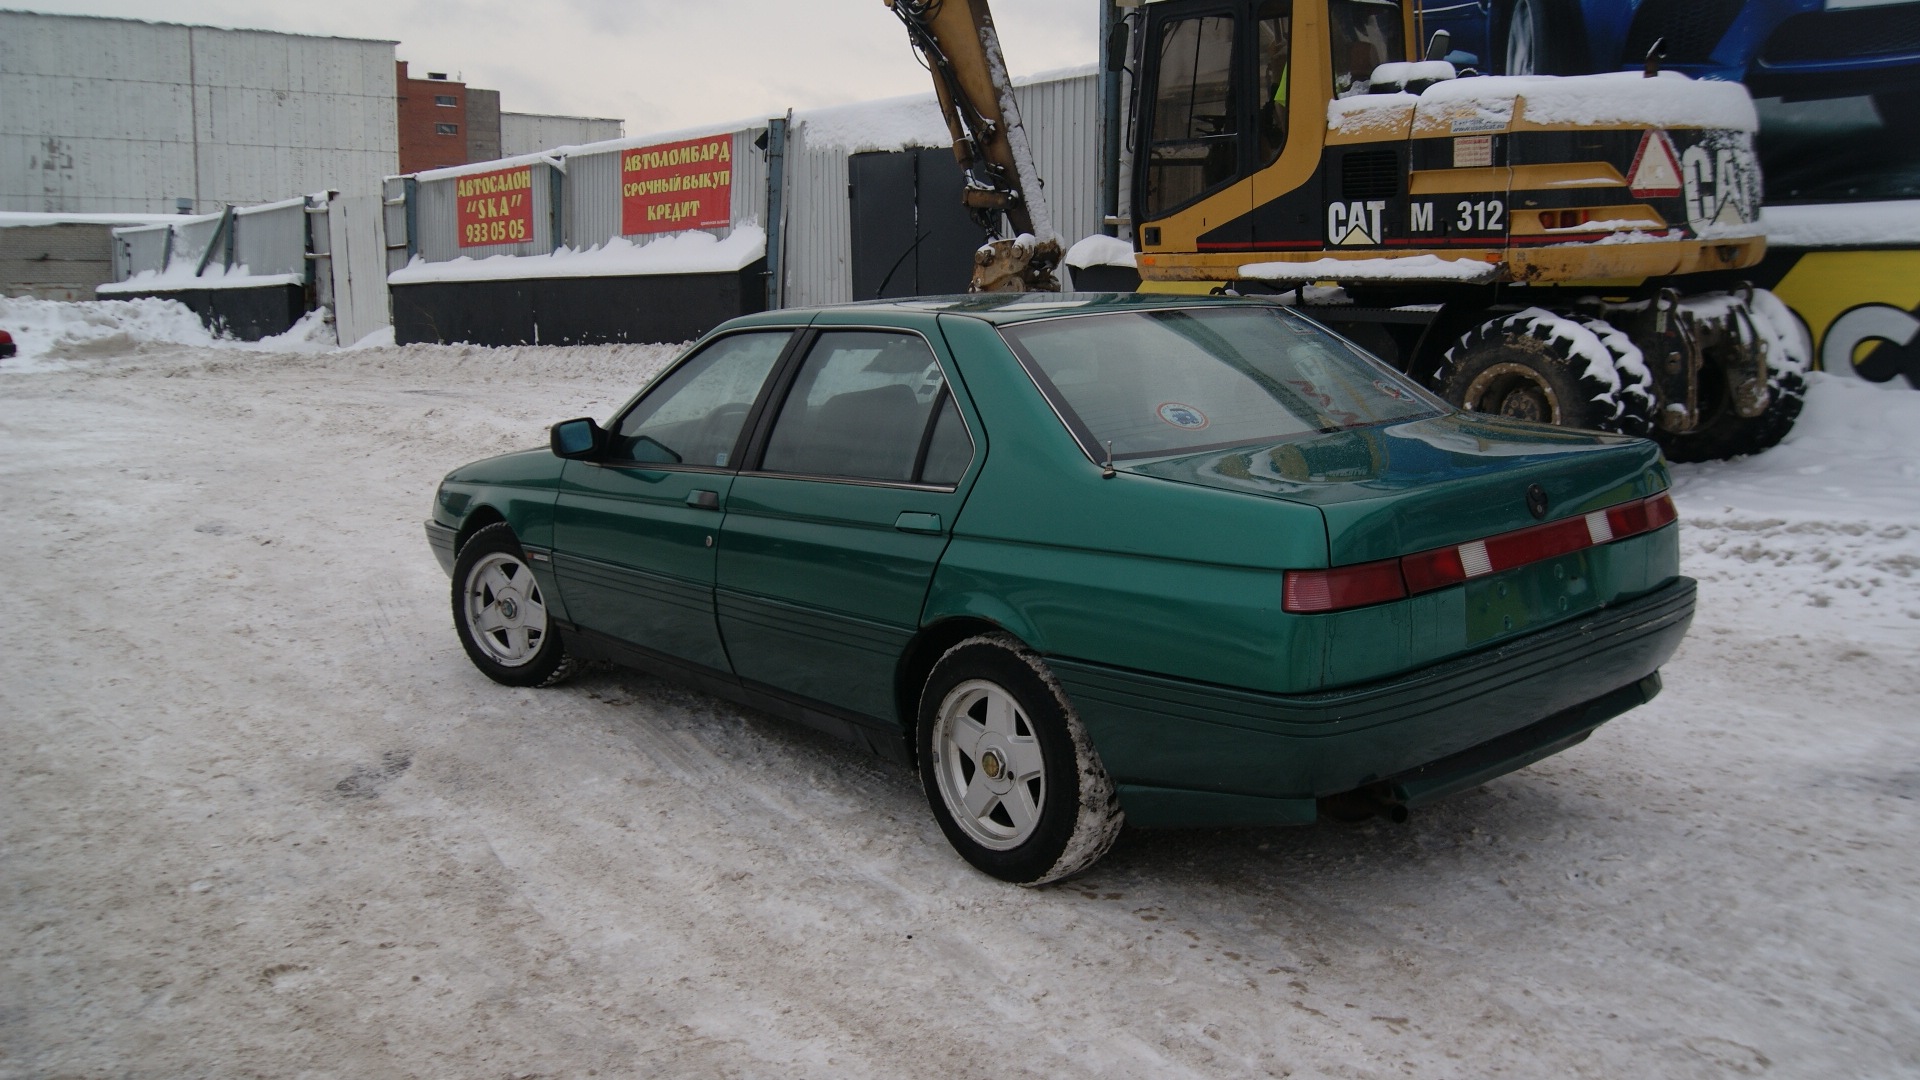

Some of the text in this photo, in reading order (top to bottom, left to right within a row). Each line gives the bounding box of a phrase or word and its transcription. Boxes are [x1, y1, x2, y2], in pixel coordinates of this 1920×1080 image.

[624, 141, 730, 172] АВТОЛОМБАРД
[458, 170, 531, 197] АВТОСАЛОН
[623, 170, 730, 197] СРОЧНЫЙ ВЫКУП
[647, 200, 700, 222] КРЕДИТ
[1328, 200, 1504, 245] CAT M 312
[466, 218, 525, 243] 933 05 05
